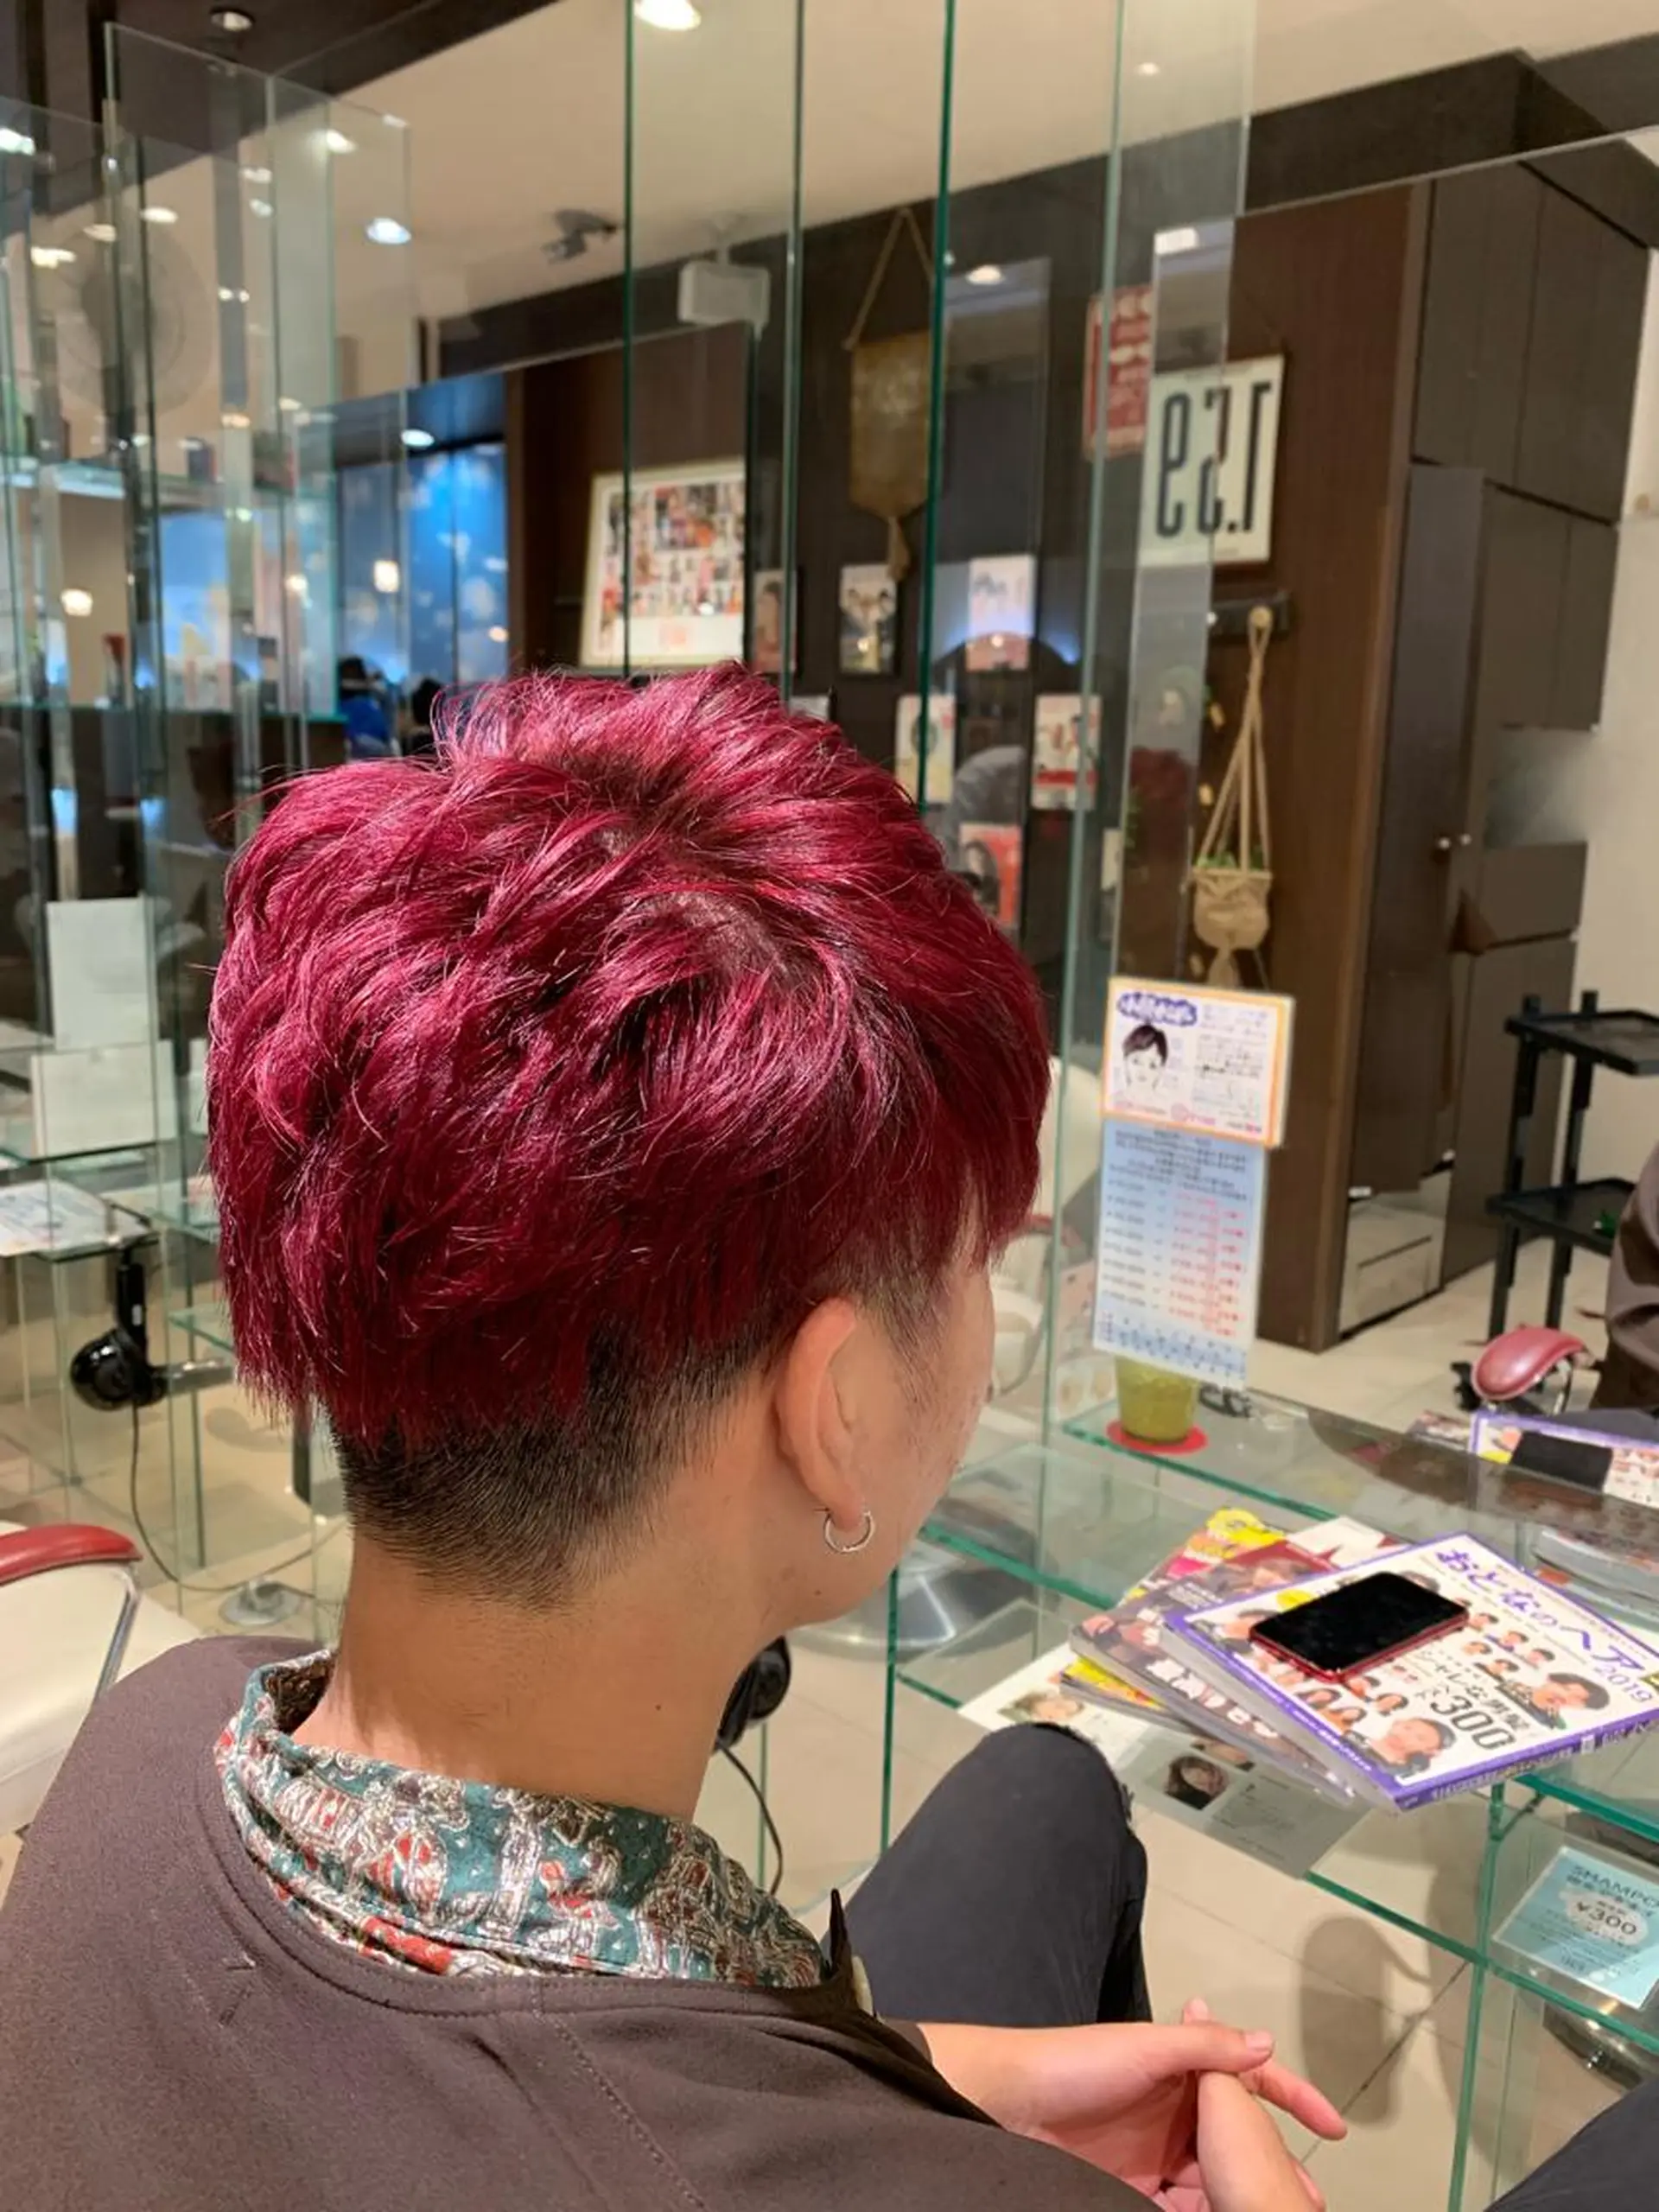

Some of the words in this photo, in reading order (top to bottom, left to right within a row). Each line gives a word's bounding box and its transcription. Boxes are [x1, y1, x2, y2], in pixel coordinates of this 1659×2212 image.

[1435, 1549, 1646, 1671] おとなのヘア
[1593, 1665, 1654, 1704] 2019
[1430, 1694, 1517, 1751] 300
[1575, 1901, 1637, 1936] ¥300
